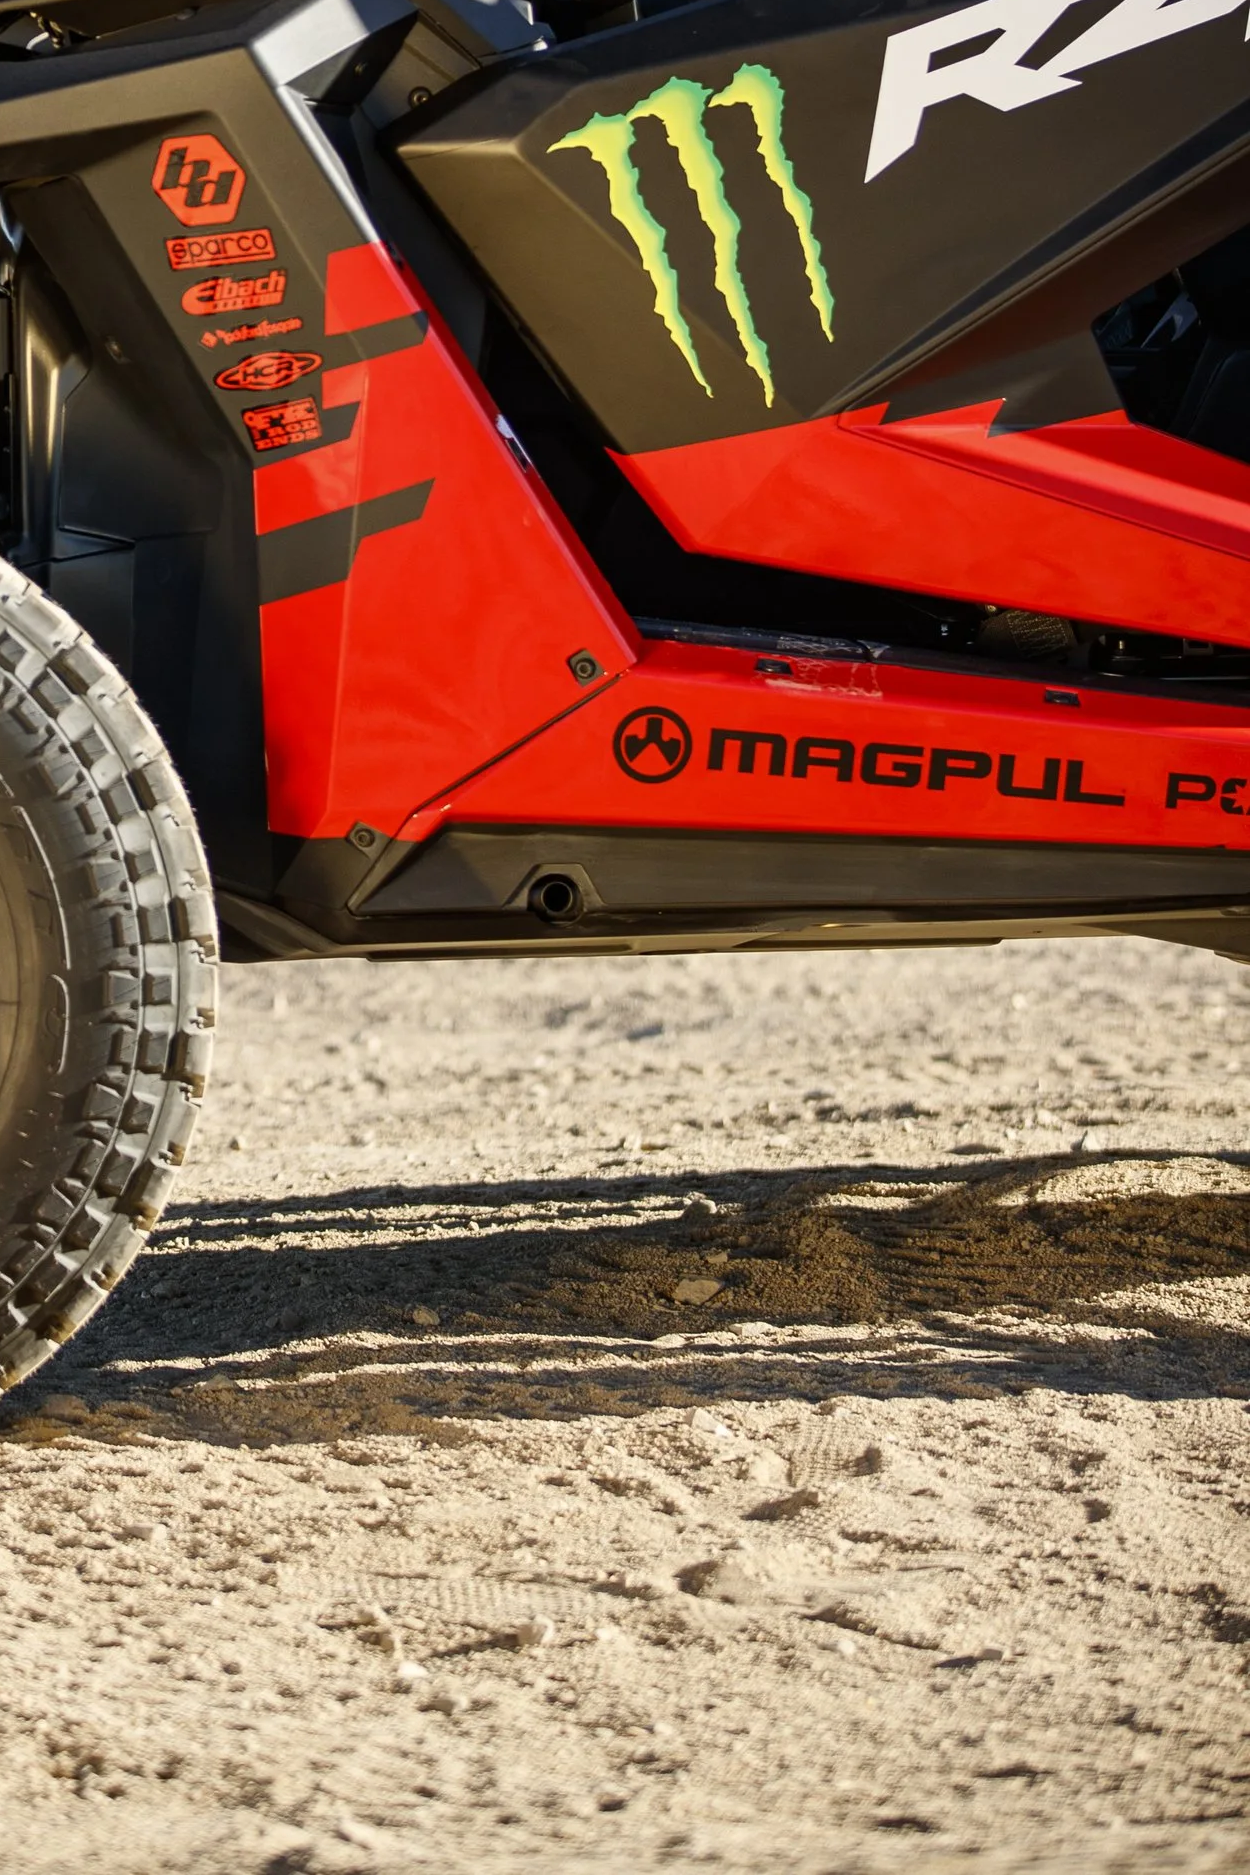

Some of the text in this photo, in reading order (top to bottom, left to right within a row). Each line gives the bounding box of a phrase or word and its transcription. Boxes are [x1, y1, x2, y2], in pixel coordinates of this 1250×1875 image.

[171, 232, 270, 266] sparco
[181, 270, 286, 316] Eibach
[242, 359, 294, 382] HCR
[255, 429, 321, 450] ENDS
[706, 727, 1126, 807] MAGPUL
